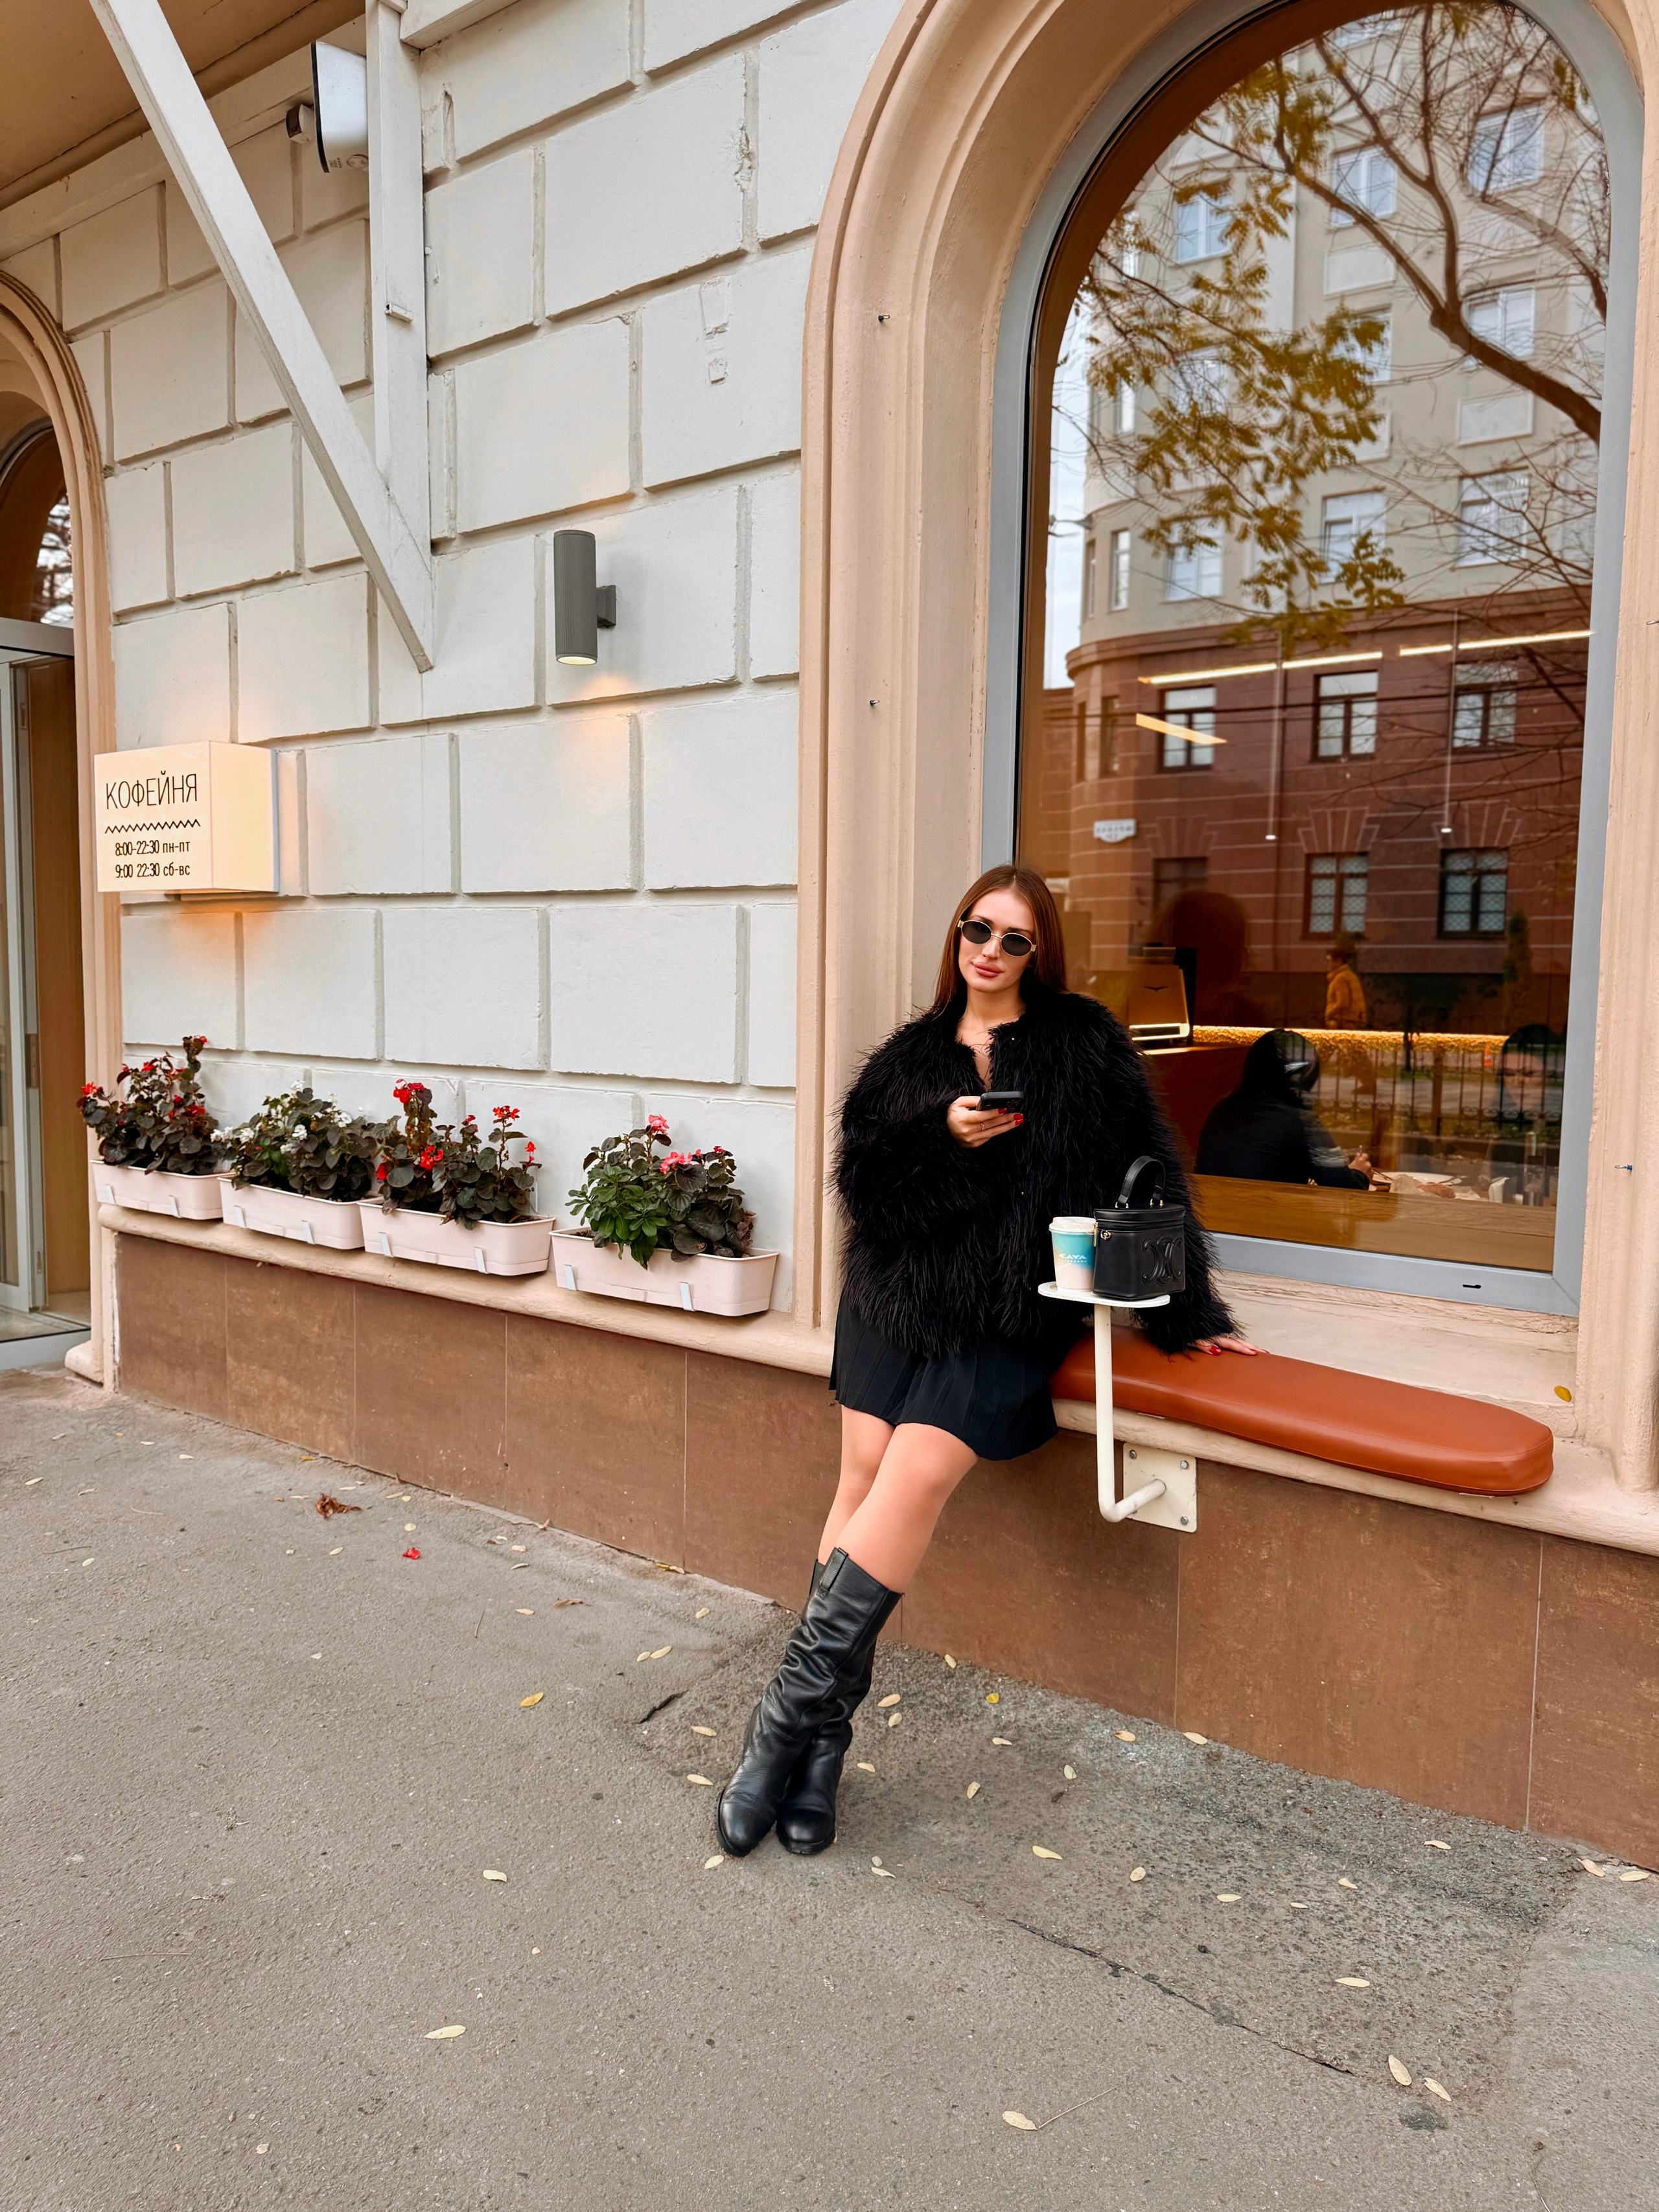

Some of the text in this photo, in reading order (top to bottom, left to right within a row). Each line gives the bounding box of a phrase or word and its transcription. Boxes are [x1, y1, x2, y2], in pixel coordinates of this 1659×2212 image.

[106, 769, 198, 810] КОФЕЙНЯ
[162, 841, 191, 854] пн-пт
[115, 861, 191, 878] 9:00 22:30 сб-вс
